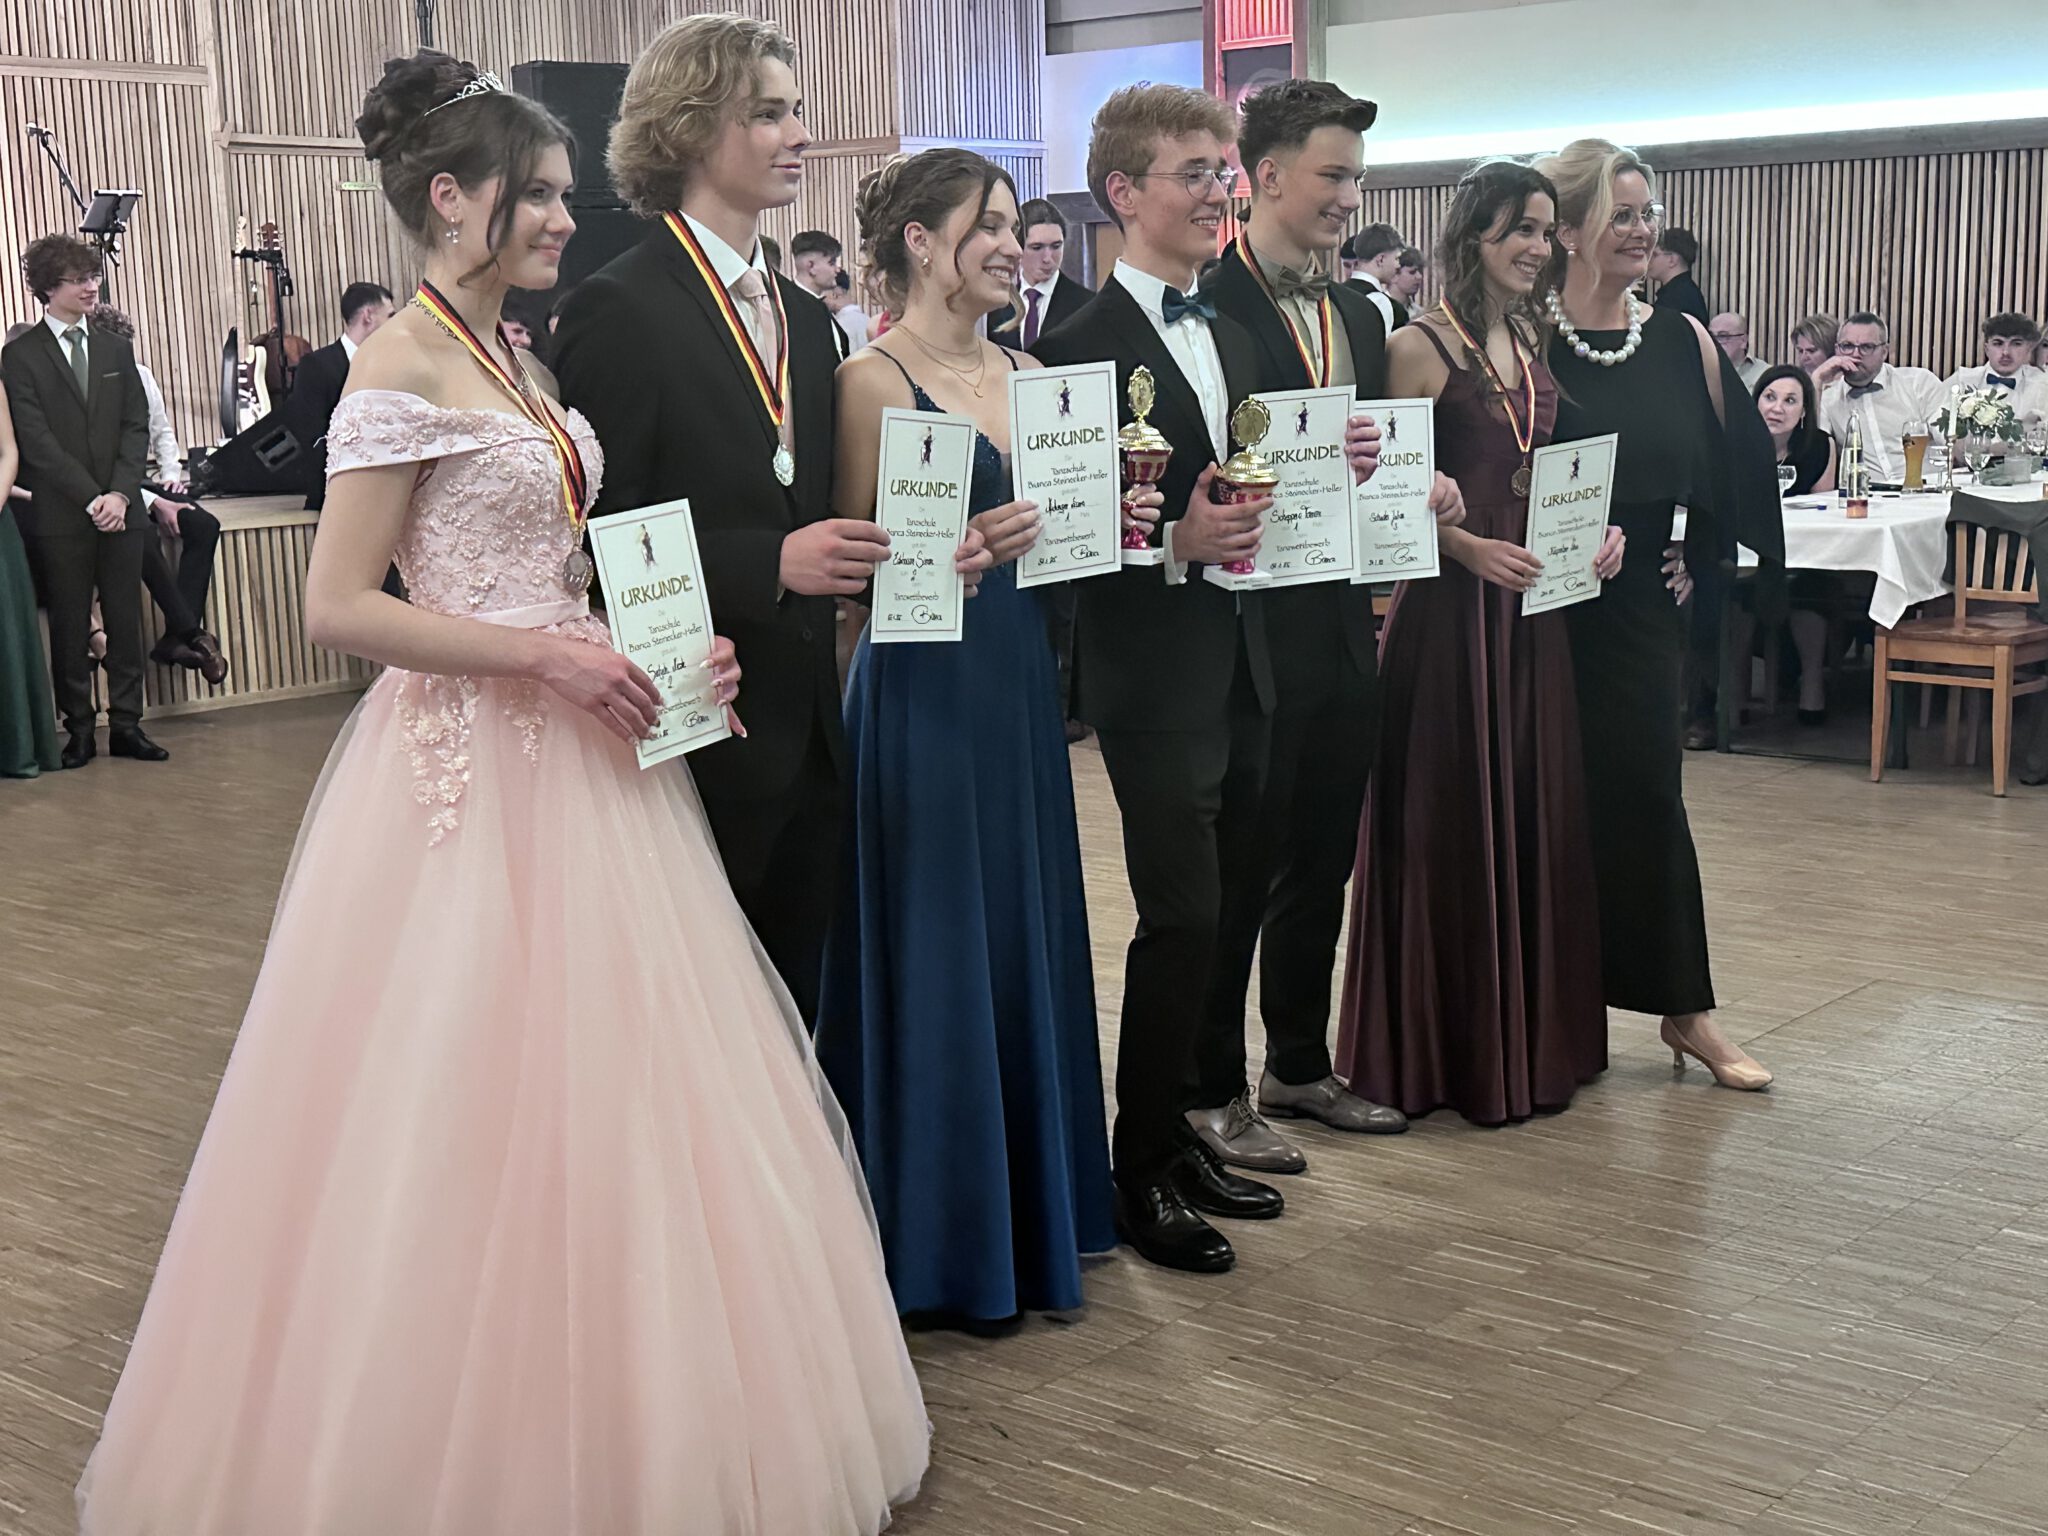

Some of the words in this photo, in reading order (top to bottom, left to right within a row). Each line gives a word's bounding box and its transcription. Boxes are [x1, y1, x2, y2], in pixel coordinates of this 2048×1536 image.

[1027, 427, 1106, 451] URKUNDE
[1378, 452, 1424, 467] KUNDE
[890, 479, 958, 499] URKUNDE
[1541, 485, 1602, 508] URKUNDE
[622, 575, 693, 608] URKUNDE
